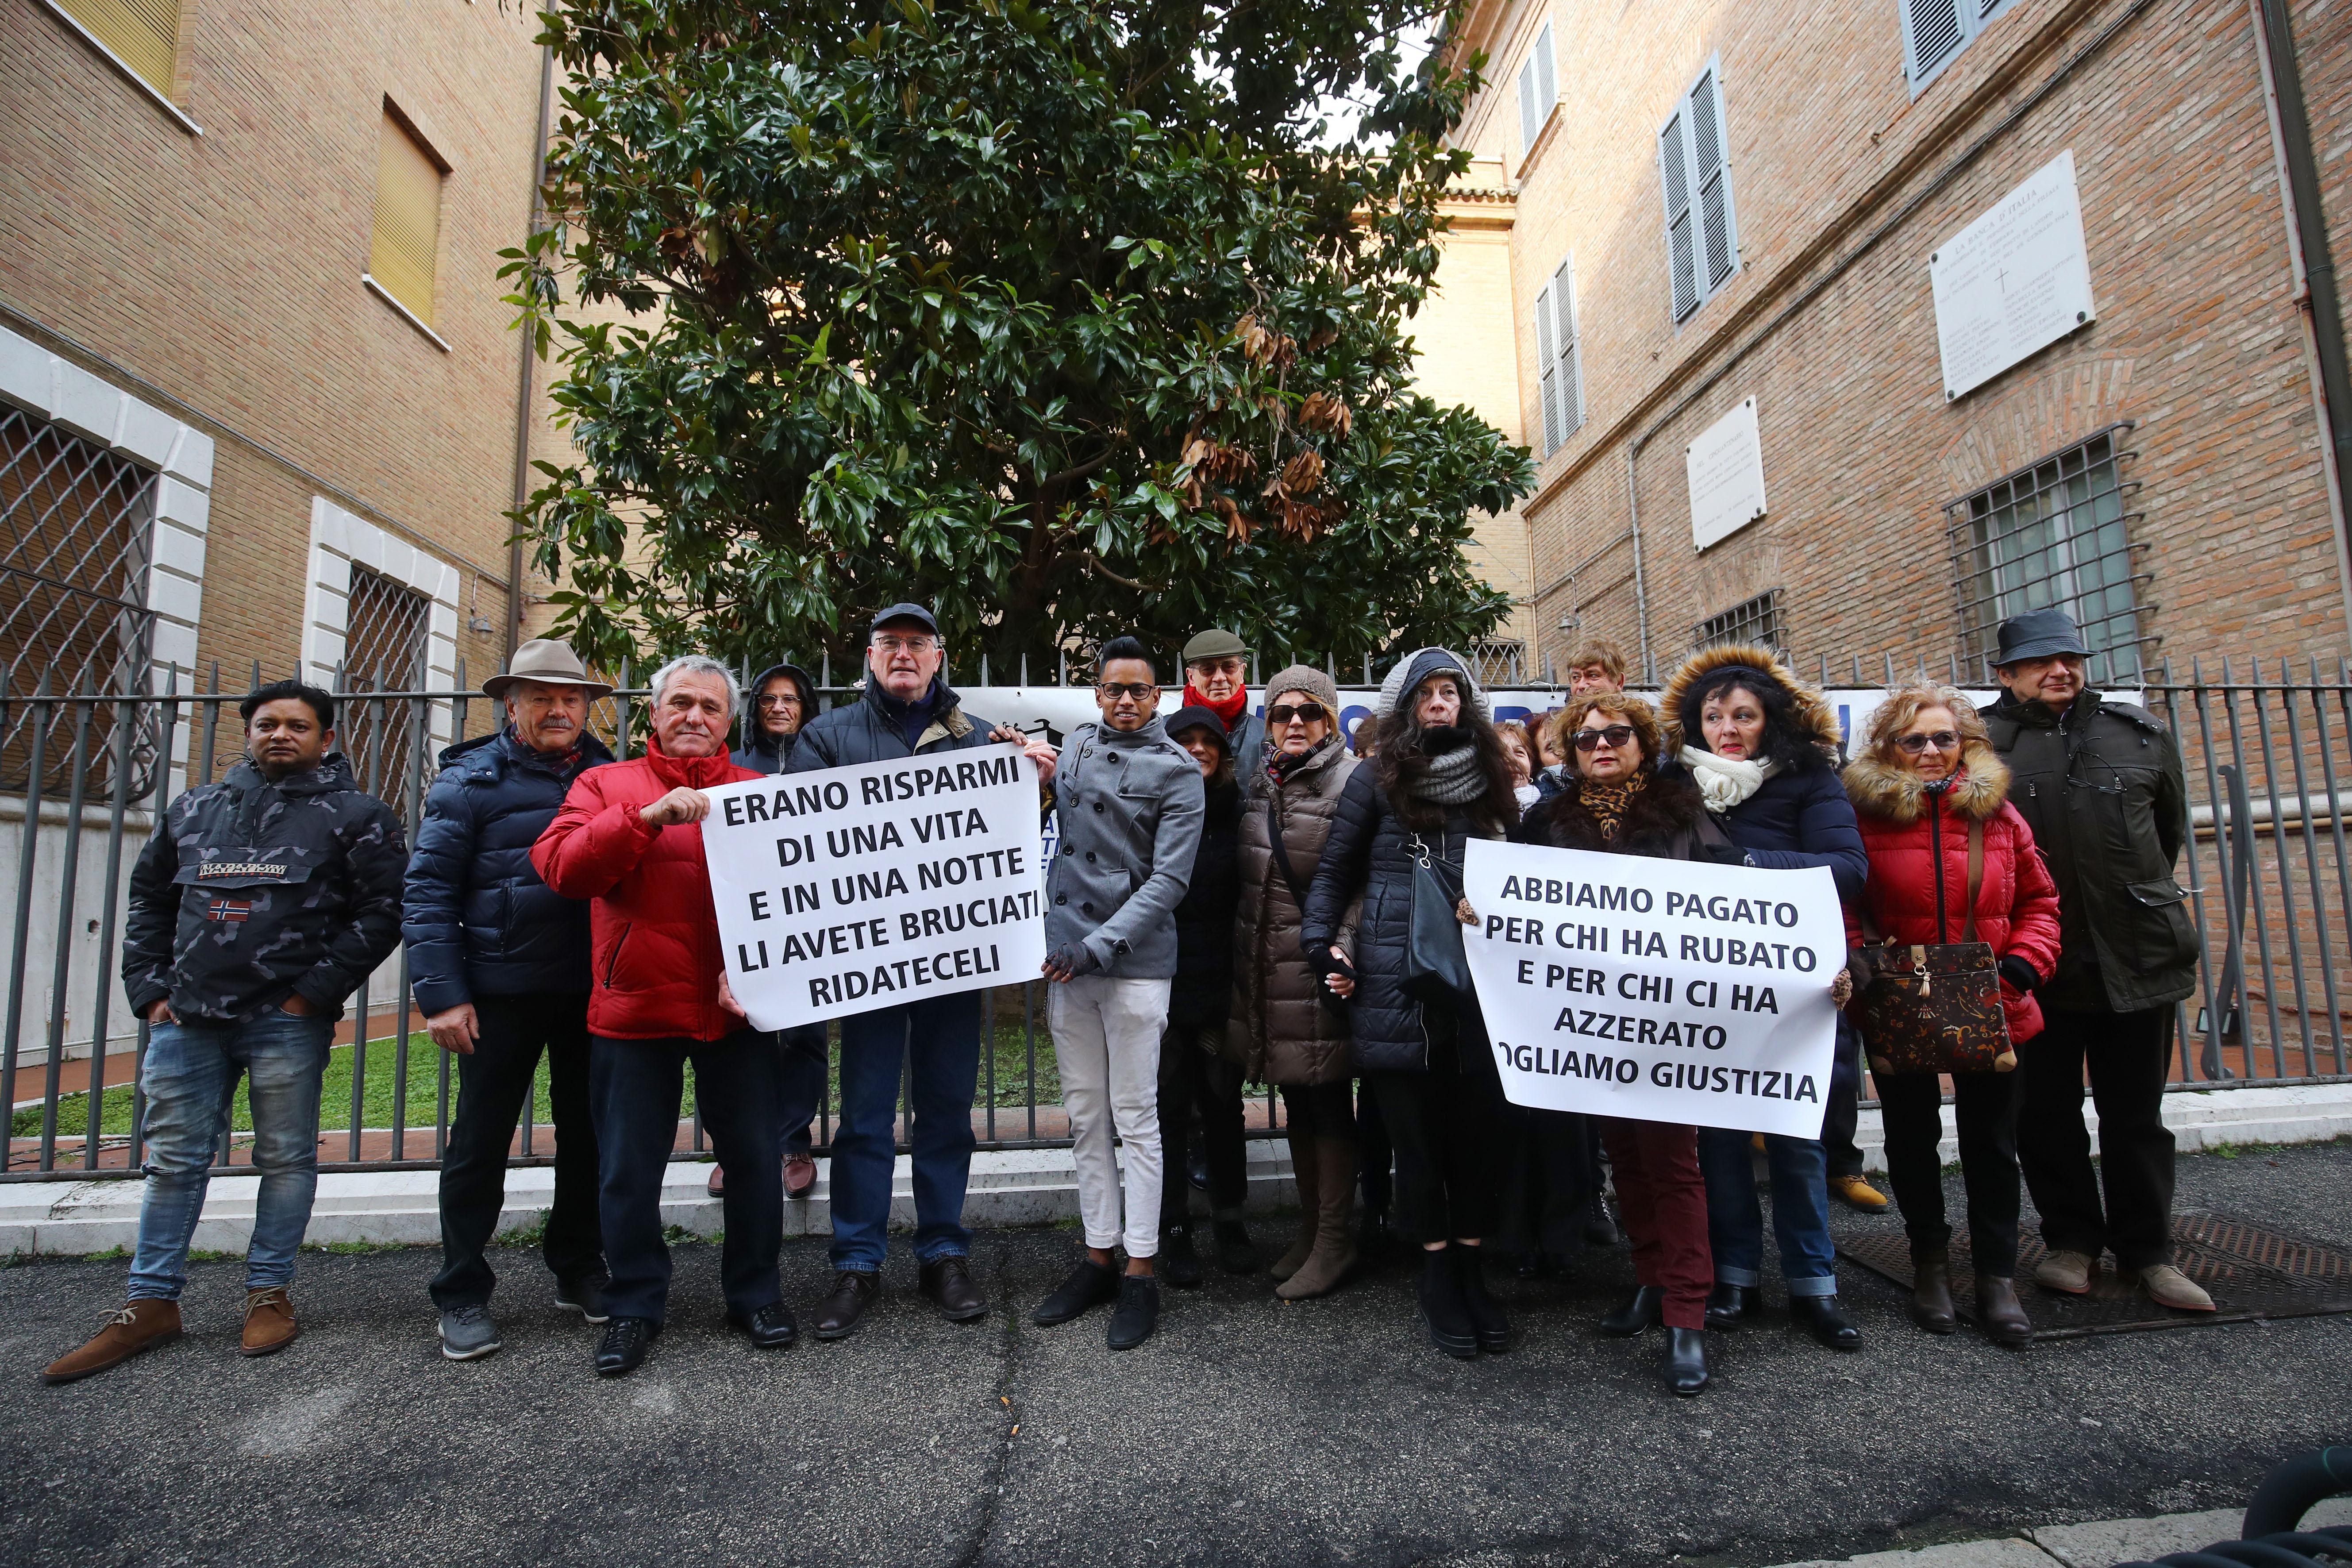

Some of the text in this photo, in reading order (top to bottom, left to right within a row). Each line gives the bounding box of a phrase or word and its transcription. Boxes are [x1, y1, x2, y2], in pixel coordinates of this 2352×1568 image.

[2018, 201, 2035, 218] DELLA
[2038, 183, 2059, 203] FILIALE
[1956, 242, 1964, 254] LA
[1968, 220, 1994, 245] BANCA
[724, 756, 1019, 826] ERANO RISPARMI
[777, 808, 988, 867] DI UNA VITA
[749, 848, 1024, 921] E IN UNA NOTTE
[1501, 876, 1798, 927] ABBIAMO PAGATO
[738, 890, 1038, 972] LI AVETE BRUCIATI
[1486, 915, 1816, 972] PER CHI HA RUBATO
[809, 944, 1000, 1007] RIDATECELI
[1518, 960, 1778, 1014] E PER CHI CI HA
[1554, 1008, 1726, 1050] AZZERATO
[1651, 1062, 1817, 1103] GIUSTIZIA
